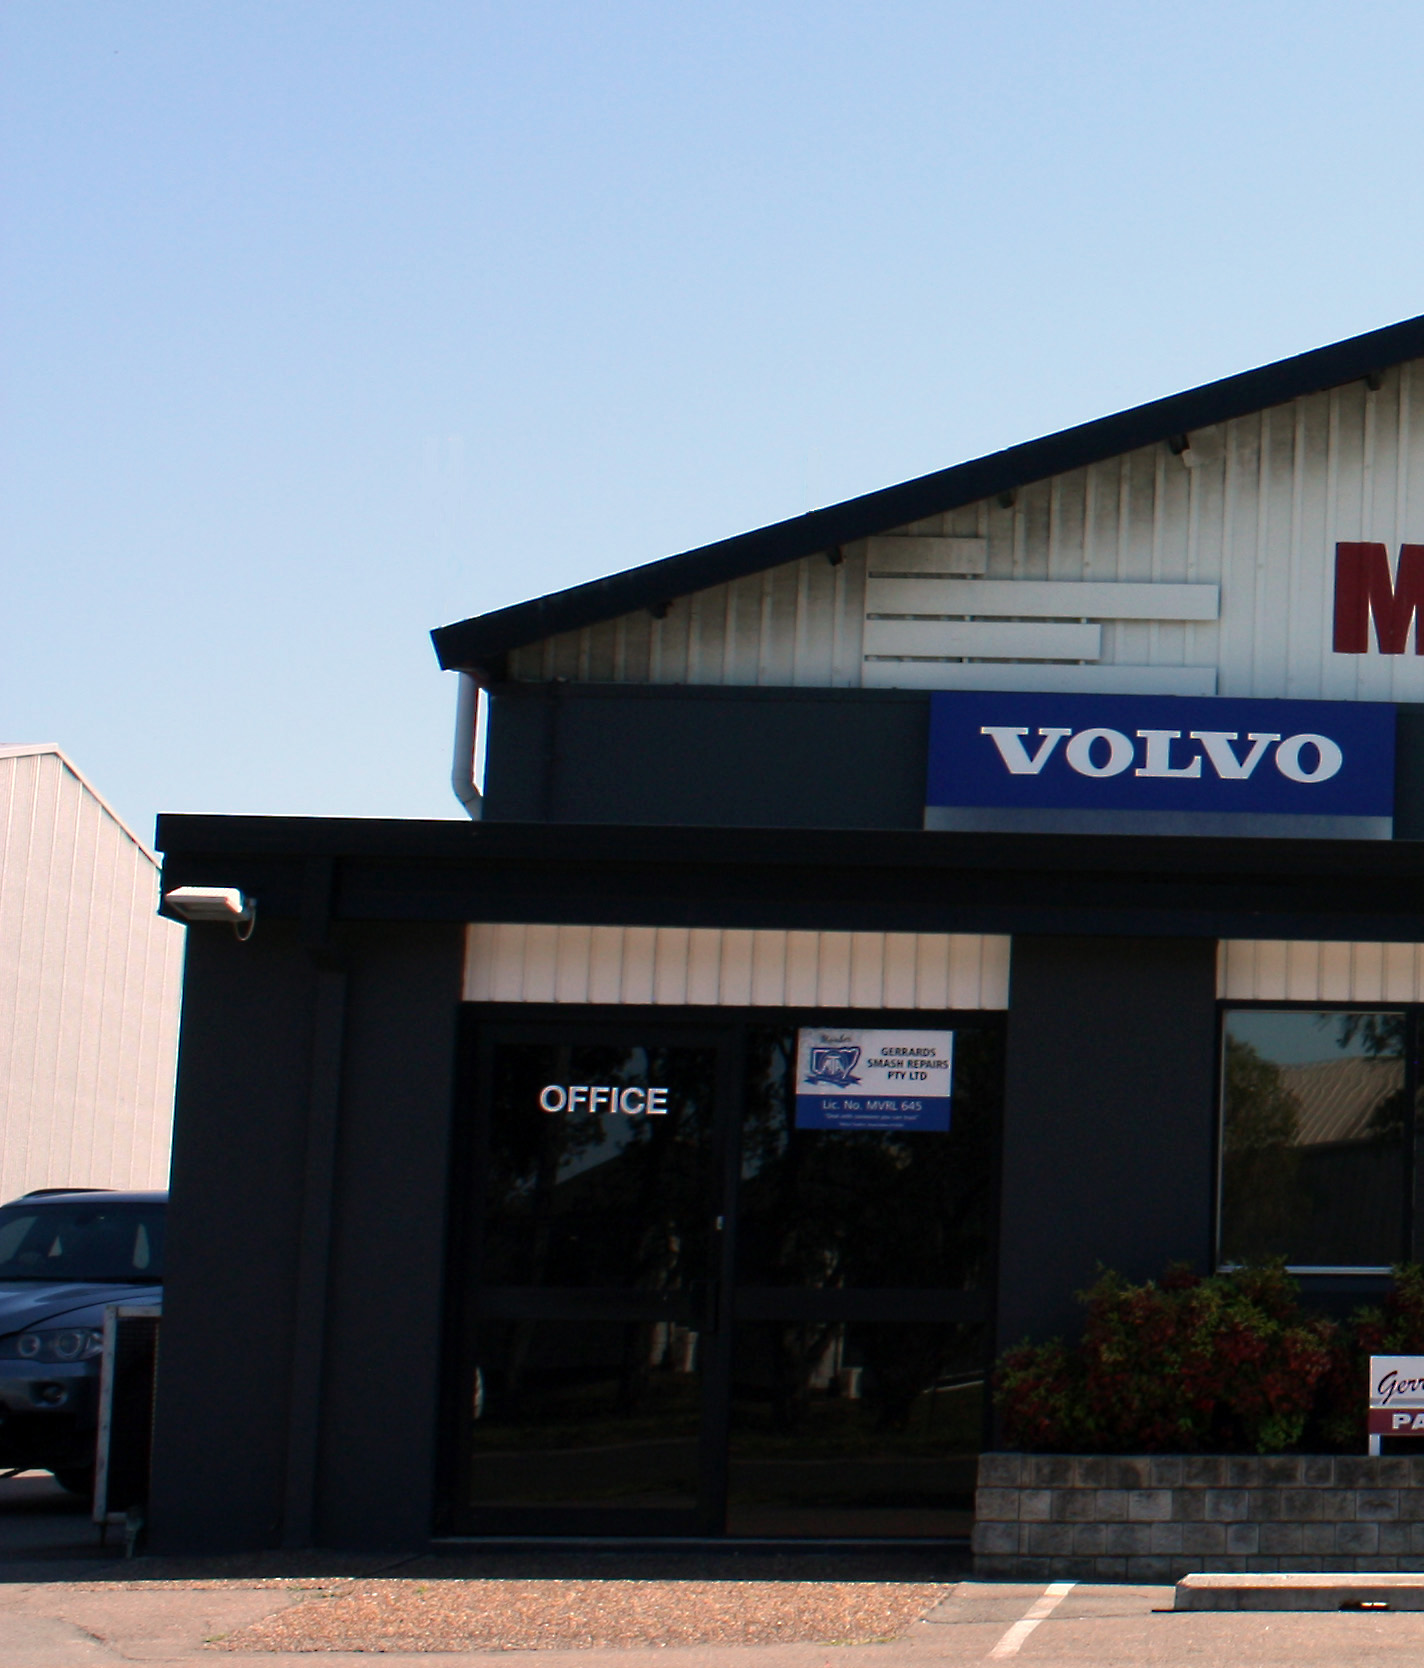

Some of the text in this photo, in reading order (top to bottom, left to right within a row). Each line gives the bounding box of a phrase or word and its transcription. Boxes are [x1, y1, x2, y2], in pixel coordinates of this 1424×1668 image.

[980, 726, 1342, 783] VOLVO
[881, 1047, 937, 1057] GERRARDS
[867, 1059, 949, 1069] SMASH REPAIRS
[888, 1071, 928, 1081] PTY LTD
[540, 1084, 668, 1115] OFFICE
[823, 1099, 923, 1111] Lic. No. MVRL 645
